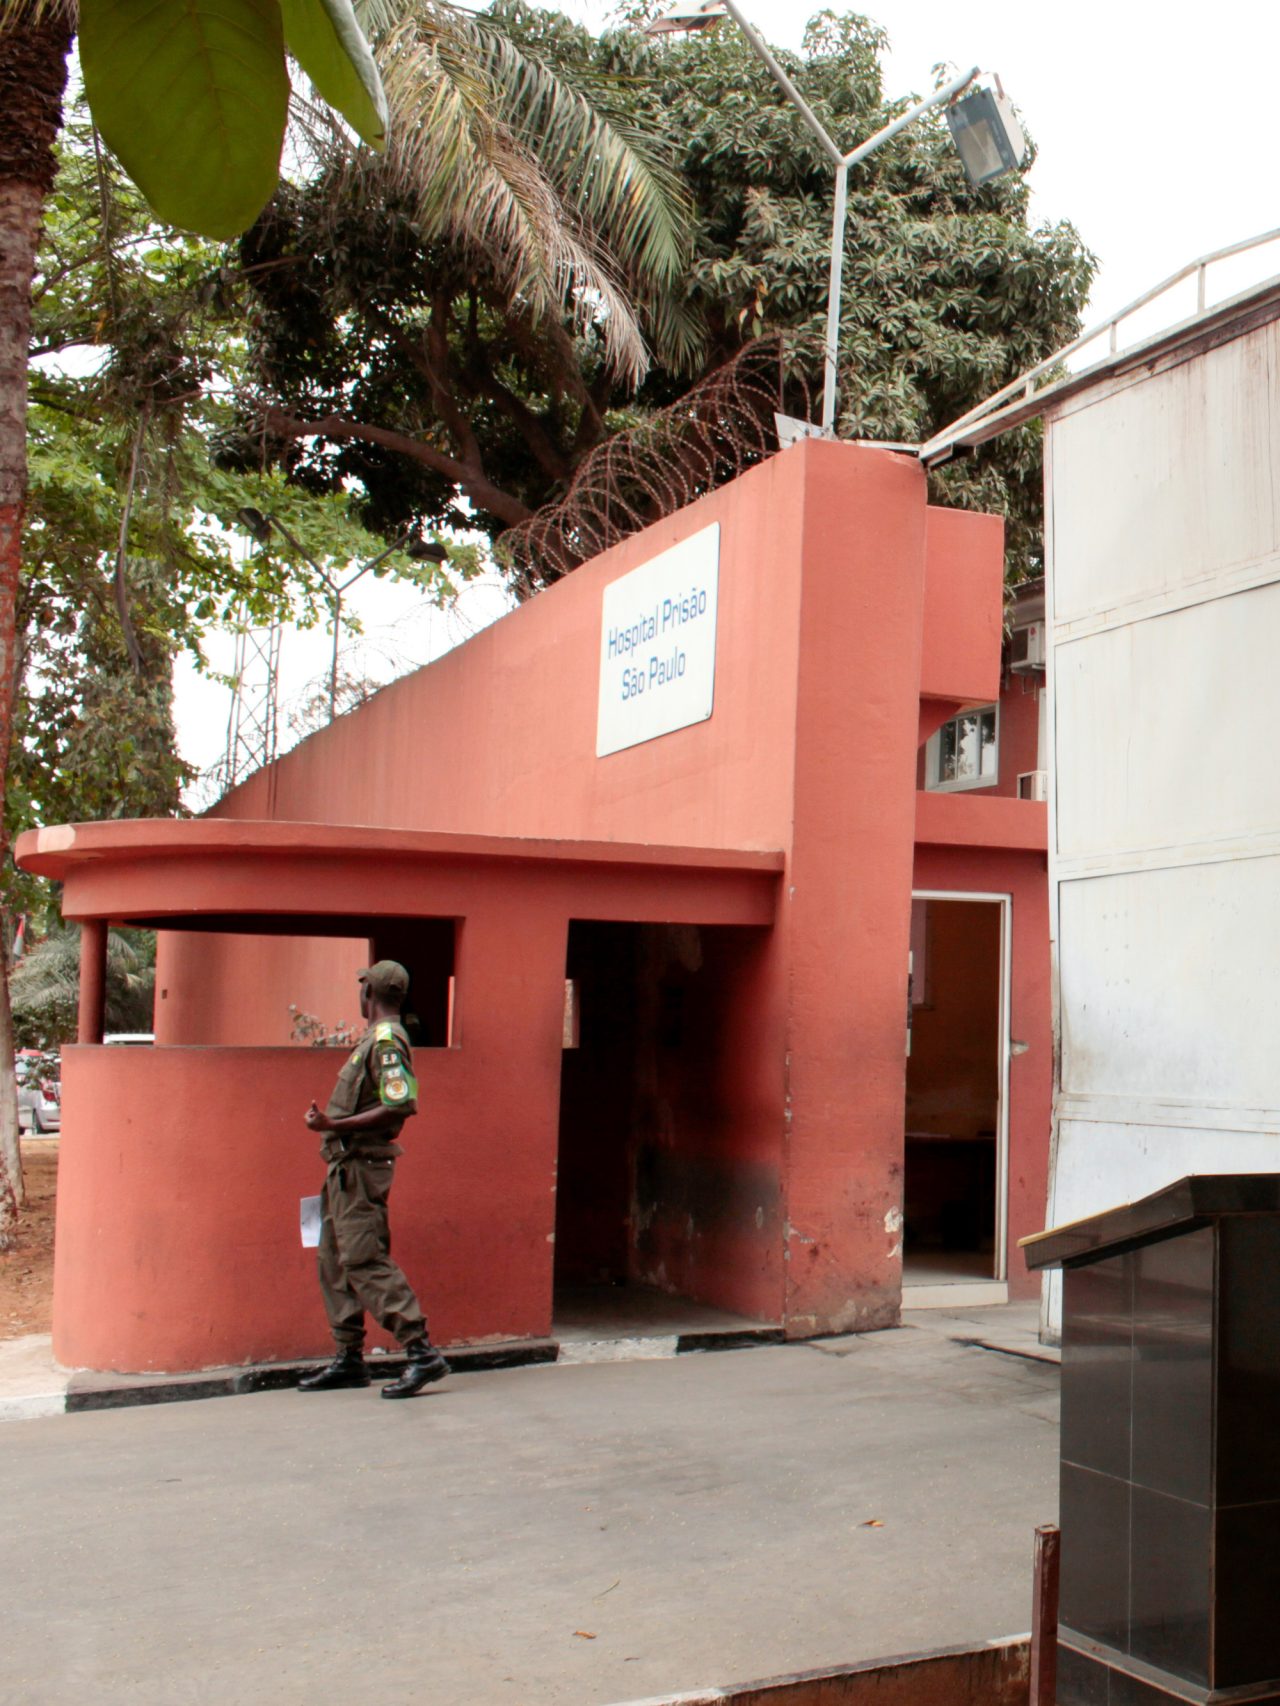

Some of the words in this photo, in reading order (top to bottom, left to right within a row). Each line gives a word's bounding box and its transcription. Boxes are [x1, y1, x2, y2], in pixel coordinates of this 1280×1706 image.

[608, 604, 659, 660] Hospital
[662, 587, 707, 633] Prisão
[621, 667, 645, 701] São
[649, 646, 686, 690] Paulo
